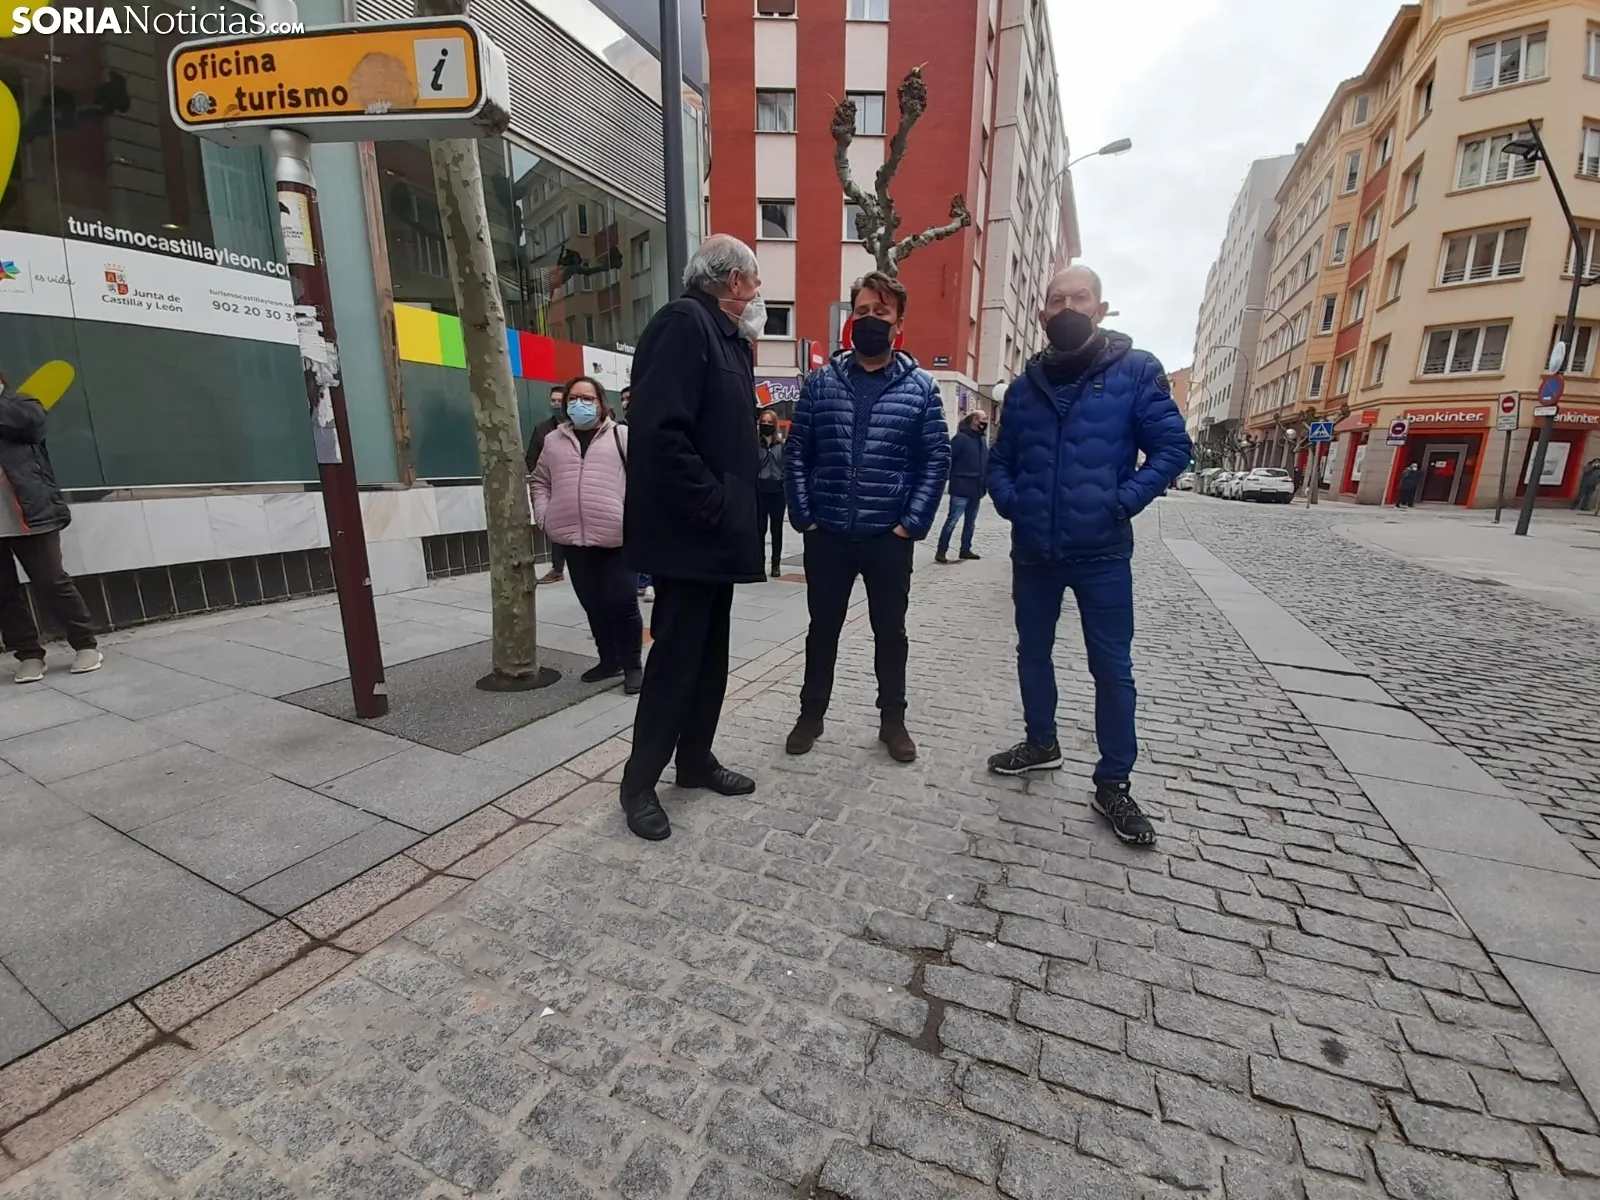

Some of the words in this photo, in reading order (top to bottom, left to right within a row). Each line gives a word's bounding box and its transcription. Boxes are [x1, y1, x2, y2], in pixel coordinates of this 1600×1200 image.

[183, 50, 276, 81] oficina
[235, 83, 348, 111] turismo
[68, 216, 290, 278] turismocastillayleon.co
[47, 274, 75, 286] vida
[102, 294, 143, 307] Castilla
[146, 301, 153, 310] y
[156, 302, 183, 313] León
[133, 289, 164, 300] Junta
[167, 294, 181, 303] de
[209, 288, 294, 309] turismocastillayleon.co
[212, 300, 240, 313] 902
[244, 305, 260, 316] 20
[265, 309, 281, 320] 30
[1553, 411, 1599, 424] ankinter.
